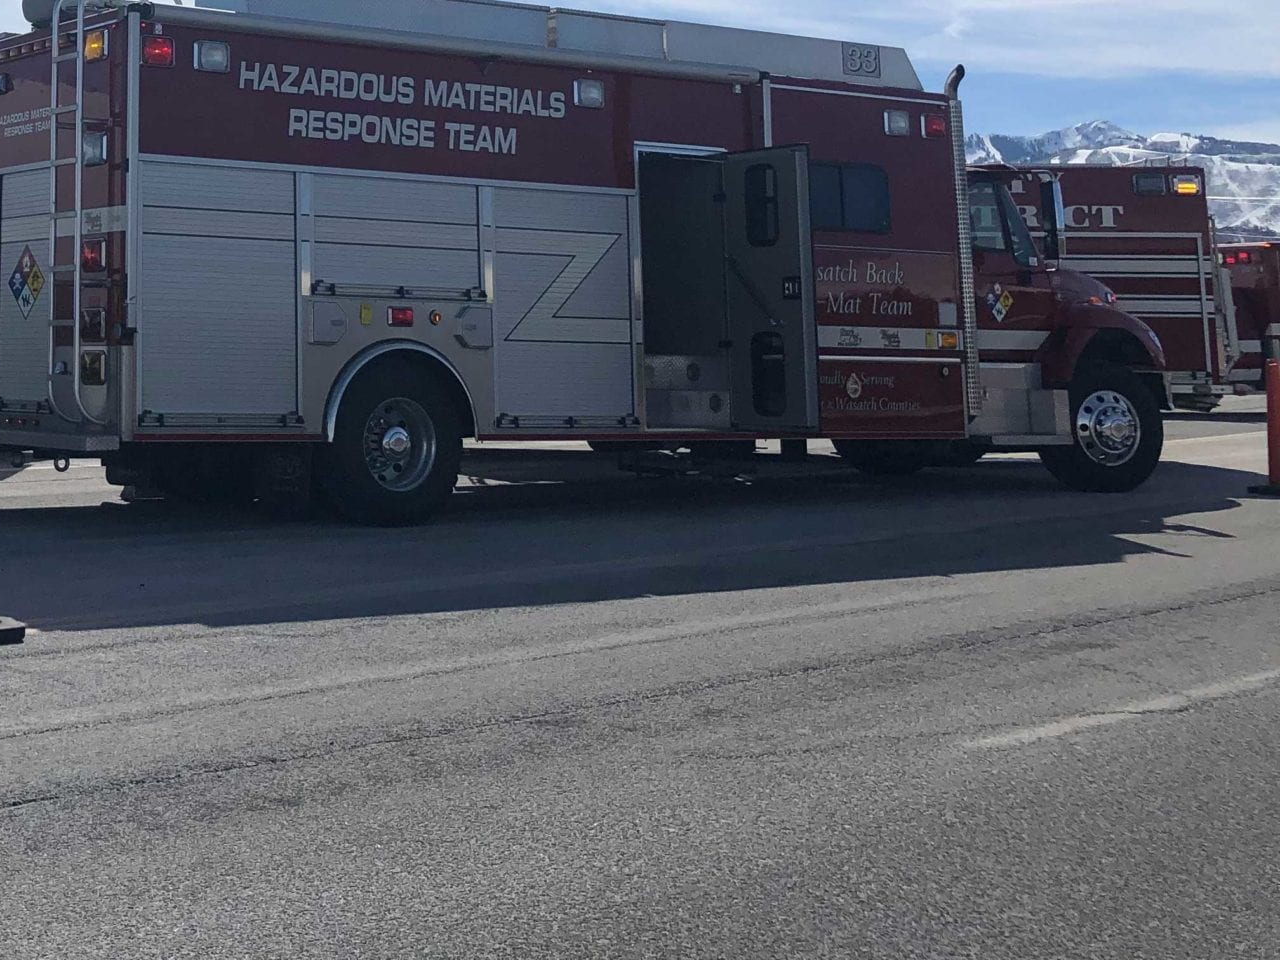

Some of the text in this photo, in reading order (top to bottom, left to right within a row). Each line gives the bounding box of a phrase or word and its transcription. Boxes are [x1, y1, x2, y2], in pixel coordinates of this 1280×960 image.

[847, 46, 877, 74] 33
[239, 61, 566, 119] HAZARDOUS MATERIALS
[4, 123, 34, 138] RESPONSE
[288, 108, 517, 155] RESPONSE TEAM
[972, 205, 1124, 228] TRCT
[817, 259, 904, 285] satch Back
[869, 292, 913, 316] Team
[861, 371, 895, 389] Serving
[835, 396, 877, 411] Wasatch
[879, 397, 920, 411] Counties
